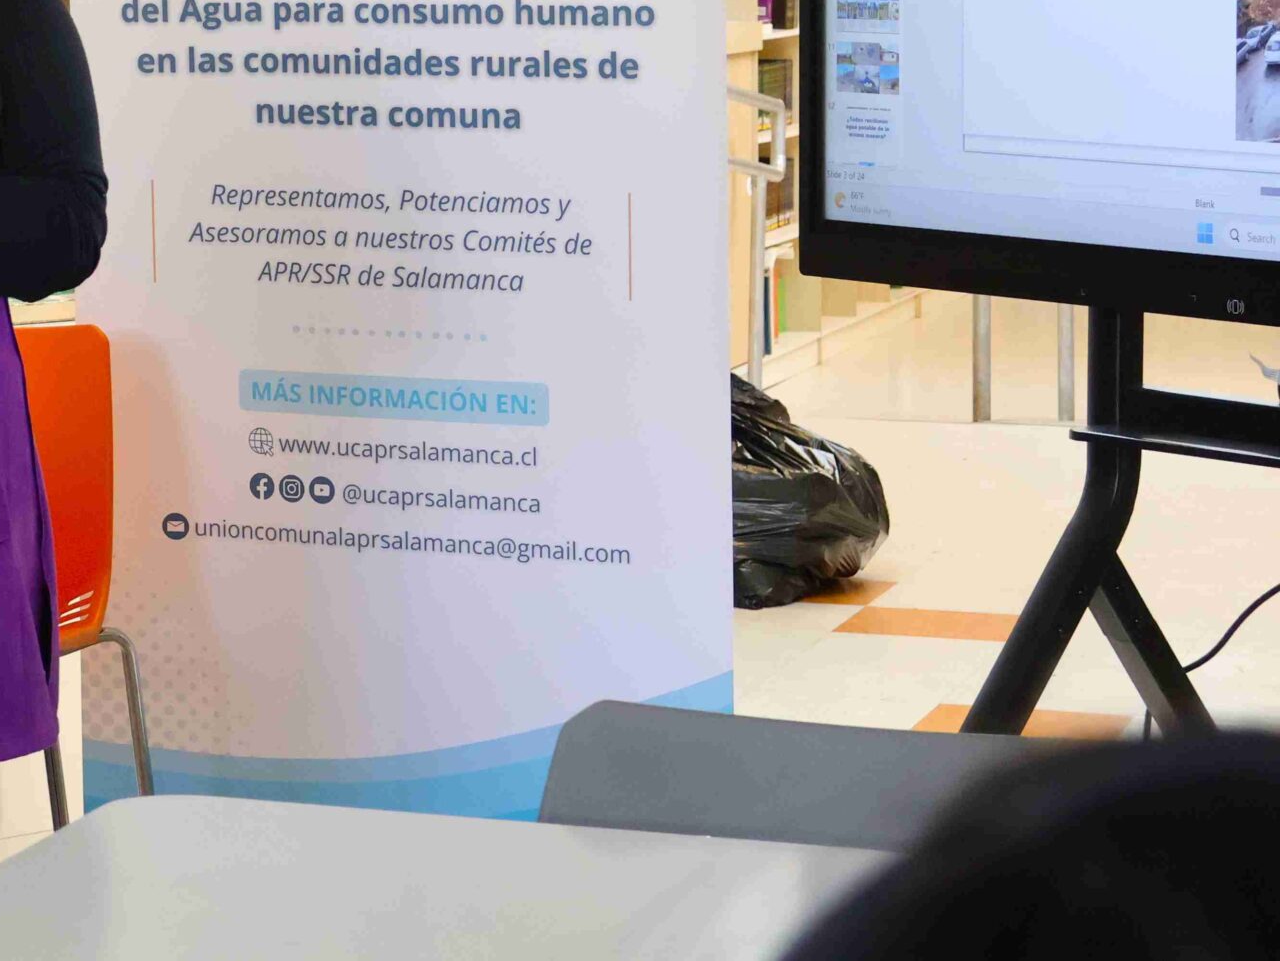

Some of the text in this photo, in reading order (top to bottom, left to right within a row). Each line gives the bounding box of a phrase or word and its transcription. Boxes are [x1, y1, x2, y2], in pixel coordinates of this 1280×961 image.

[273, 3, 344, 30] para
[354, 3, 504, 26] consumo
[137, 47, 639, 80] en las comunidades rurales de
[255, 101, 522, 129] nuestra comuna
[849, 172, 855, 180] of
[211, 184, 571, 222] Representamos, Potenciamos y
[1195, 199, 1215, 209] Blank
[189, 222, 592, 256] Asesoramos a nuestros Comités de
[1248, 232, 1276, 244] Search
[257, 262, 524, 292] APR/SSR de Salamanca
[251, 378, 536, 415] MÁS INFORMACIÓN EN:
[278, 435, 537, 467] www.ucaprsalamanca.cl
[342, 484, 541, 514] @ucaprsalamanca
[194, 519, 631, 565] unioncomunalaprsalamanca@gmail.com
